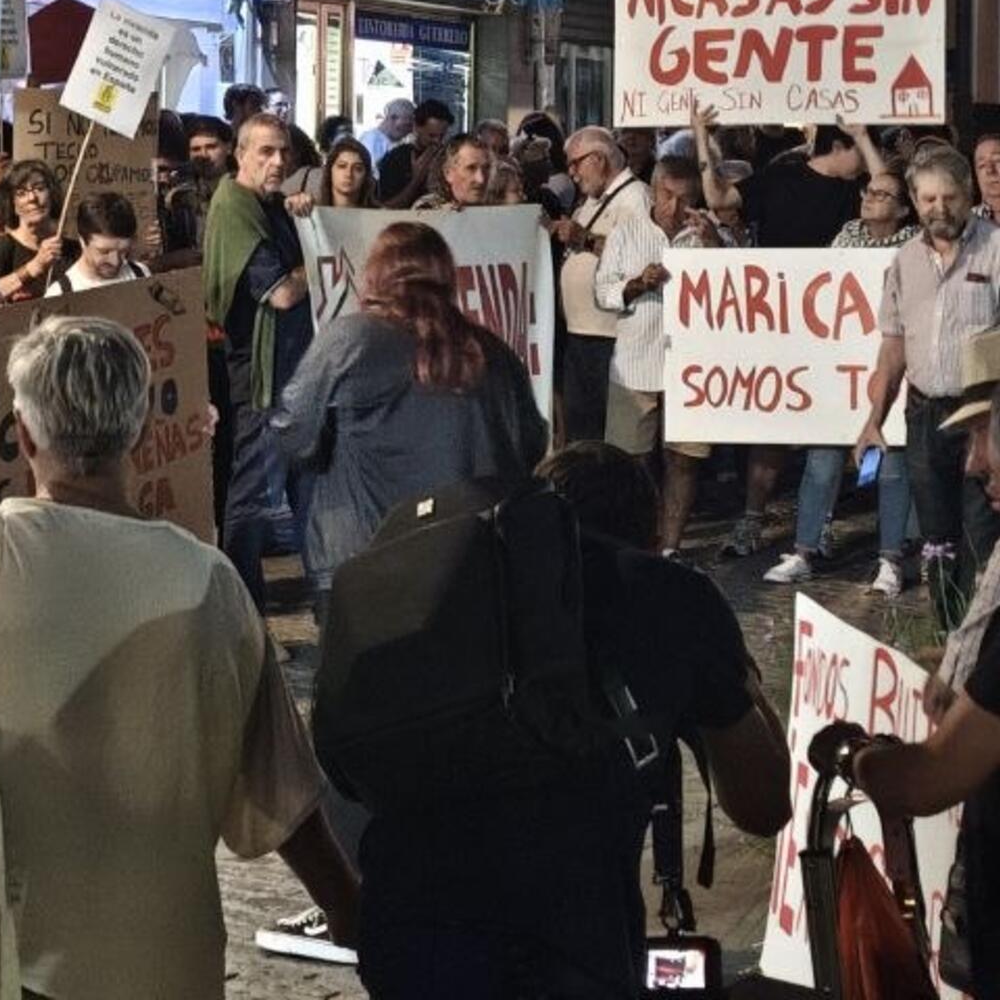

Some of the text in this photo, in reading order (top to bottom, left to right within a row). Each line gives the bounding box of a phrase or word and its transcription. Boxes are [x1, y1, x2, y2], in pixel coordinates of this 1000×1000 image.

[650, 25, 884, 86] GENTE
[721, 86, 763, 112] SIN
[787, 85, 860, 113] CASAS
[681, 364, 812, 413] SOMOS
